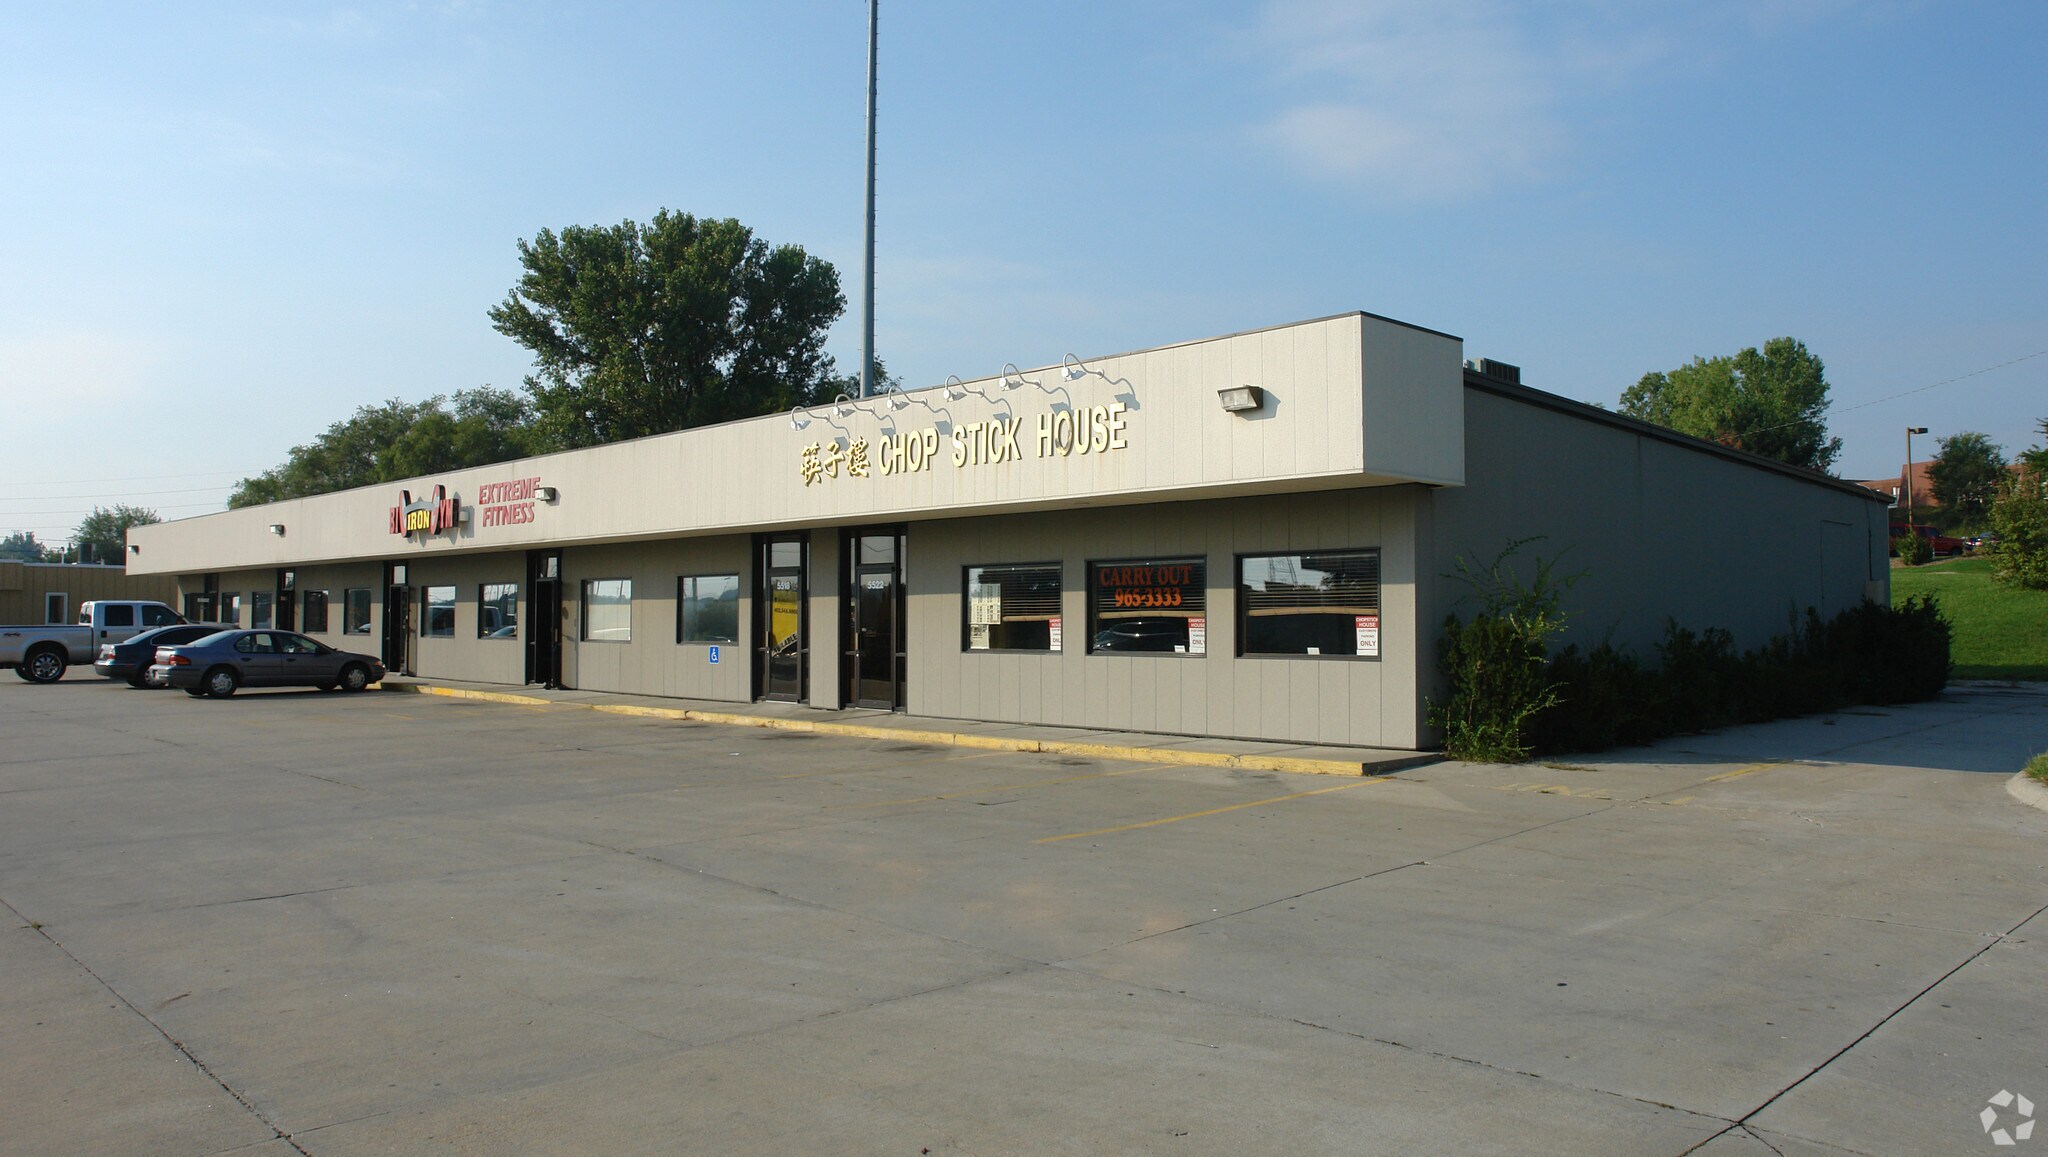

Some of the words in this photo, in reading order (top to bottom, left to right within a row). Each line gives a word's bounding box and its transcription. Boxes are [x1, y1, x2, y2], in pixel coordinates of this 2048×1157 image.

[877, 427, 939, 476] CHOP
[952, 416, 1022, 468] STICK
[1036, 402, 1128, 457] HOUSE
[407, 509, 430, 531] IRON
[482, 502, 536, 527] FITNESS
[867, 580, 884, 590] 5522
[1101, 567, 1153, 587] CARRY
[1157, 564, 1192, 585] OUT
[1114, 587, 1182, 607] 965-3333
